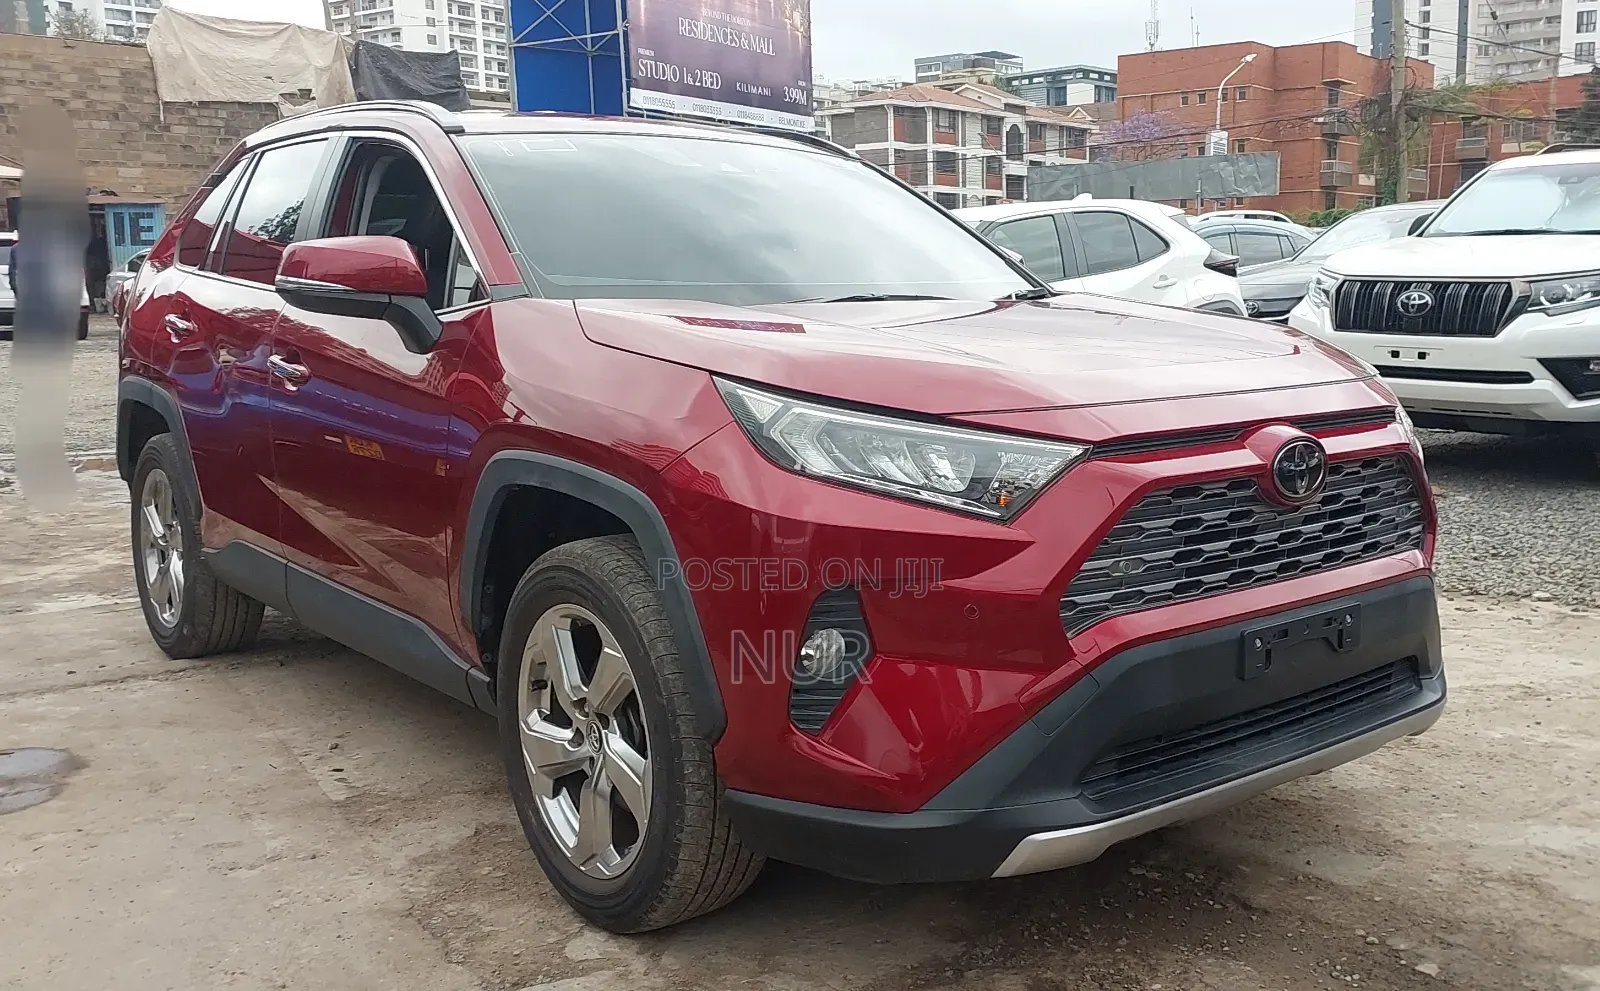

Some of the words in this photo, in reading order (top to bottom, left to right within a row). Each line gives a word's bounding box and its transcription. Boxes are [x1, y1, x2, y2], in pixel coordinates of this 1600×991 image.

[679, 17, 739, 48] RESIDENCES
[741, 33, 749, 50] &
[750, 34, 775, 56] MALL
[638, 58, 680, 82] STUDIO
[702, 70, 722, 90] BED
[736, 81, 772, 97] KILIMANI
[783, 86, 807, 106] 3.99M
